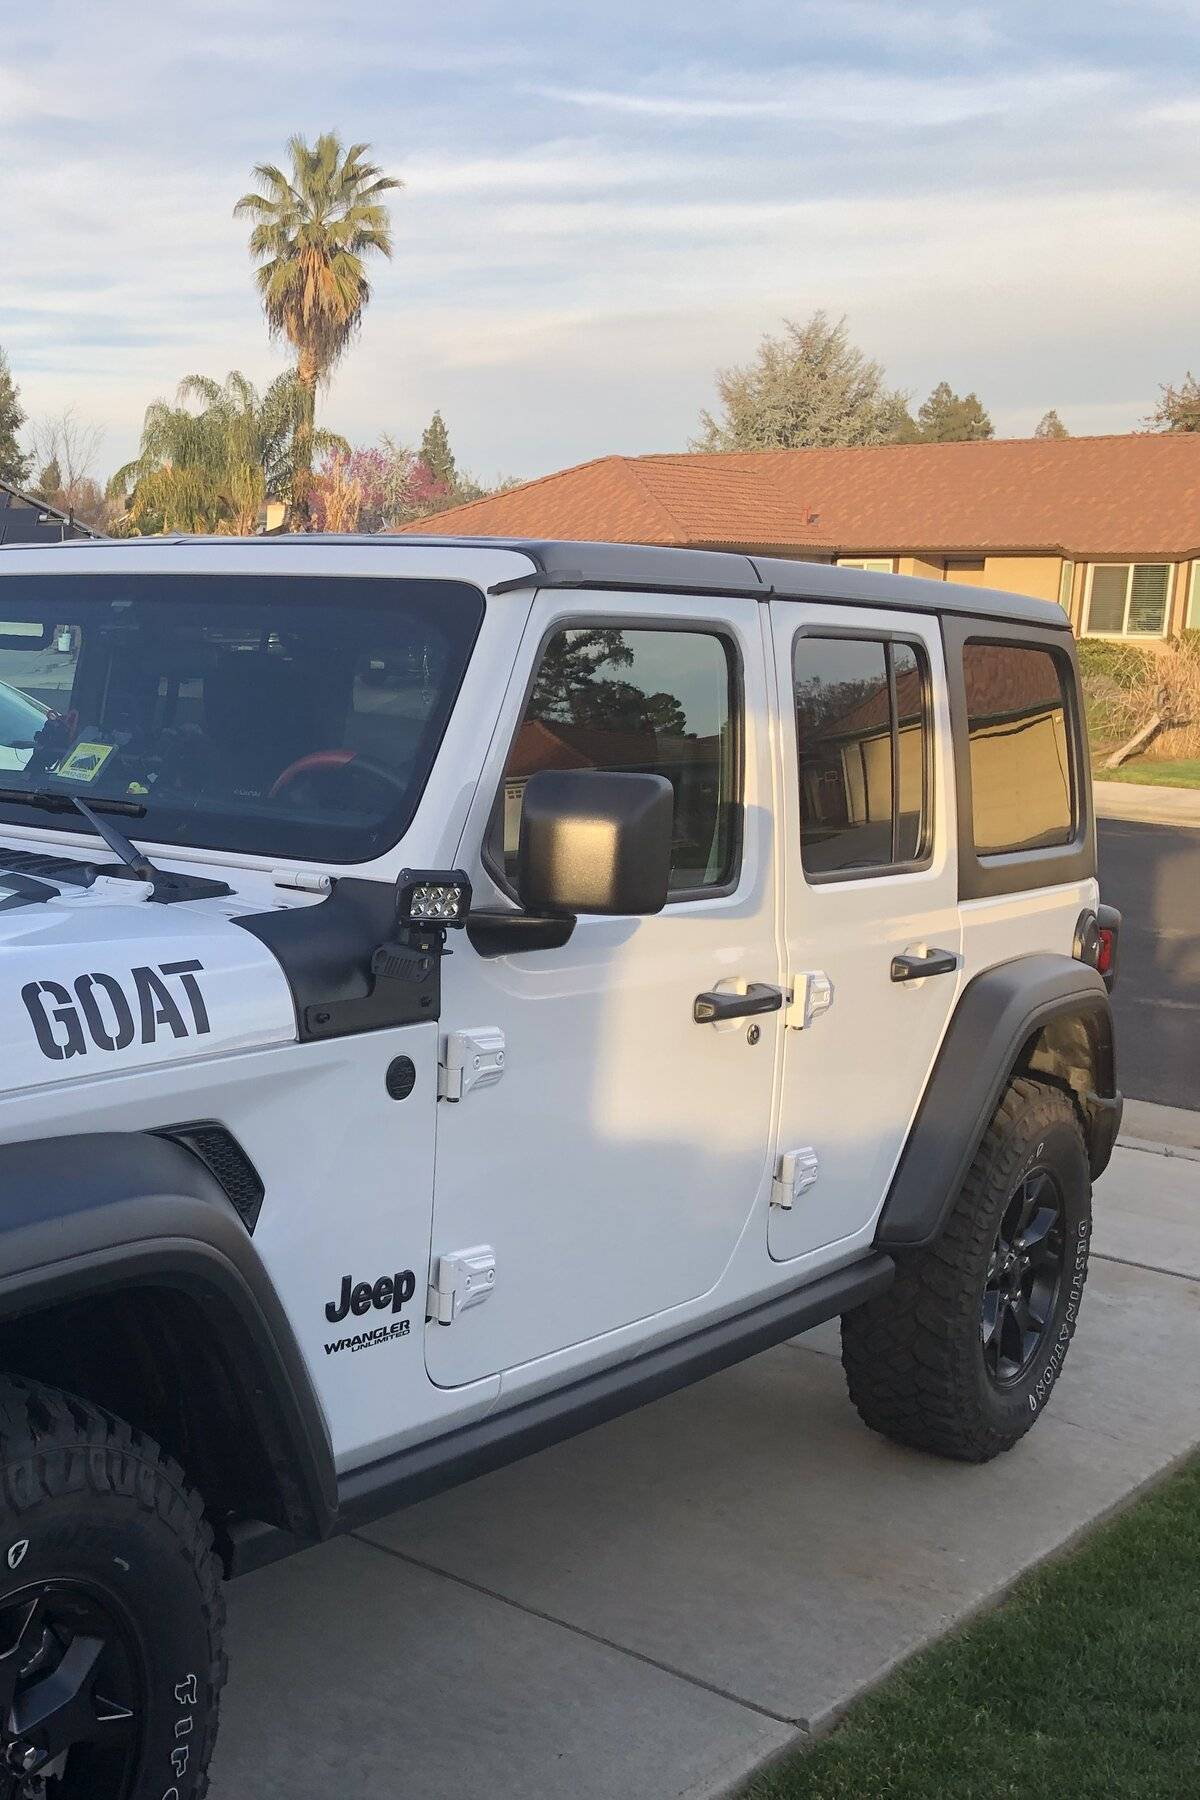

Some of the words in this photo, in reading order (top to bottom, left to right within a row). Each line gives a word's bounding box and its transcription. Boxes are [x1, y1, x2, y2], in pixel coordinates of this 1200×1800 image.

[21, 959, 211, 1060] GOAT
[325, 1269, 416, 1323] Jeep
[1035, 1219, 1089, 1401] DESTINATION
[323, 1319, 411, 1355] WRANGLER
[351, 1329, 411, 1353] UNLIMITED
